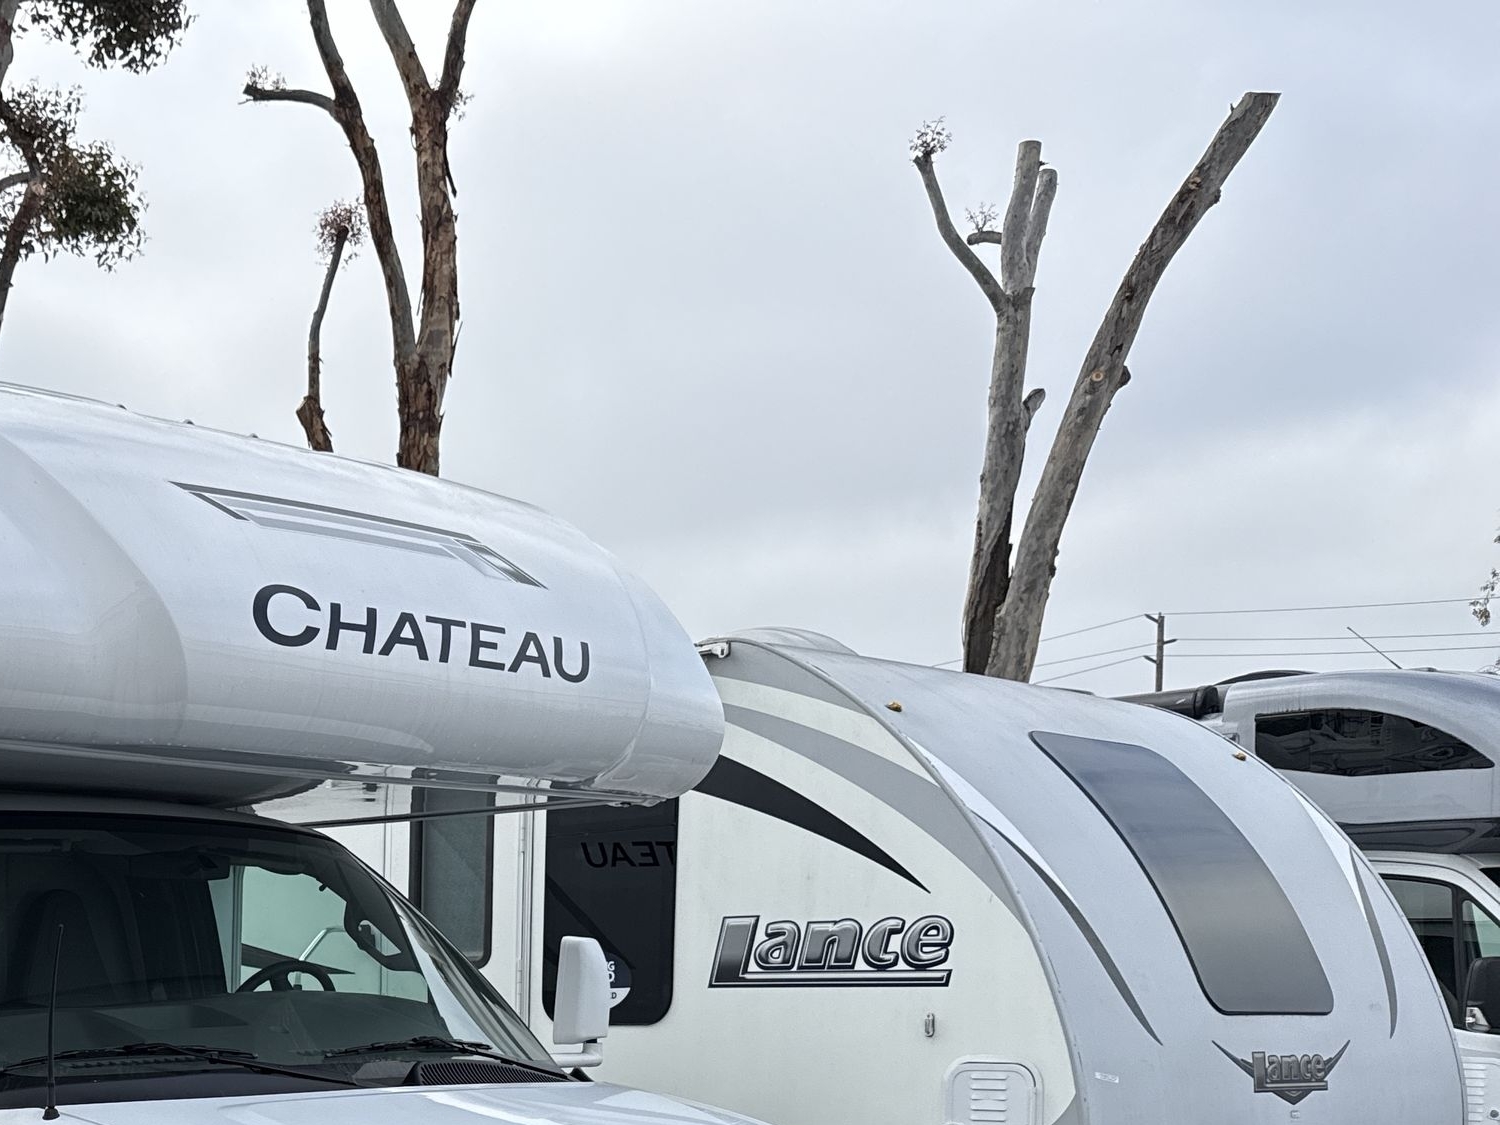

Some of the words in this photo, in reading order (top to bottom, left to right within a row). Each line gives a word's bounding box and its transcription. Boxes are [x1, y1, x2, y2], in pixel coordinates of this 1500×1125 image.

[252, 583, 591, 684] CHATEAU
[708, 915, 954, 988] Lance
[1252, 1051, 1328, 1093] Lance
